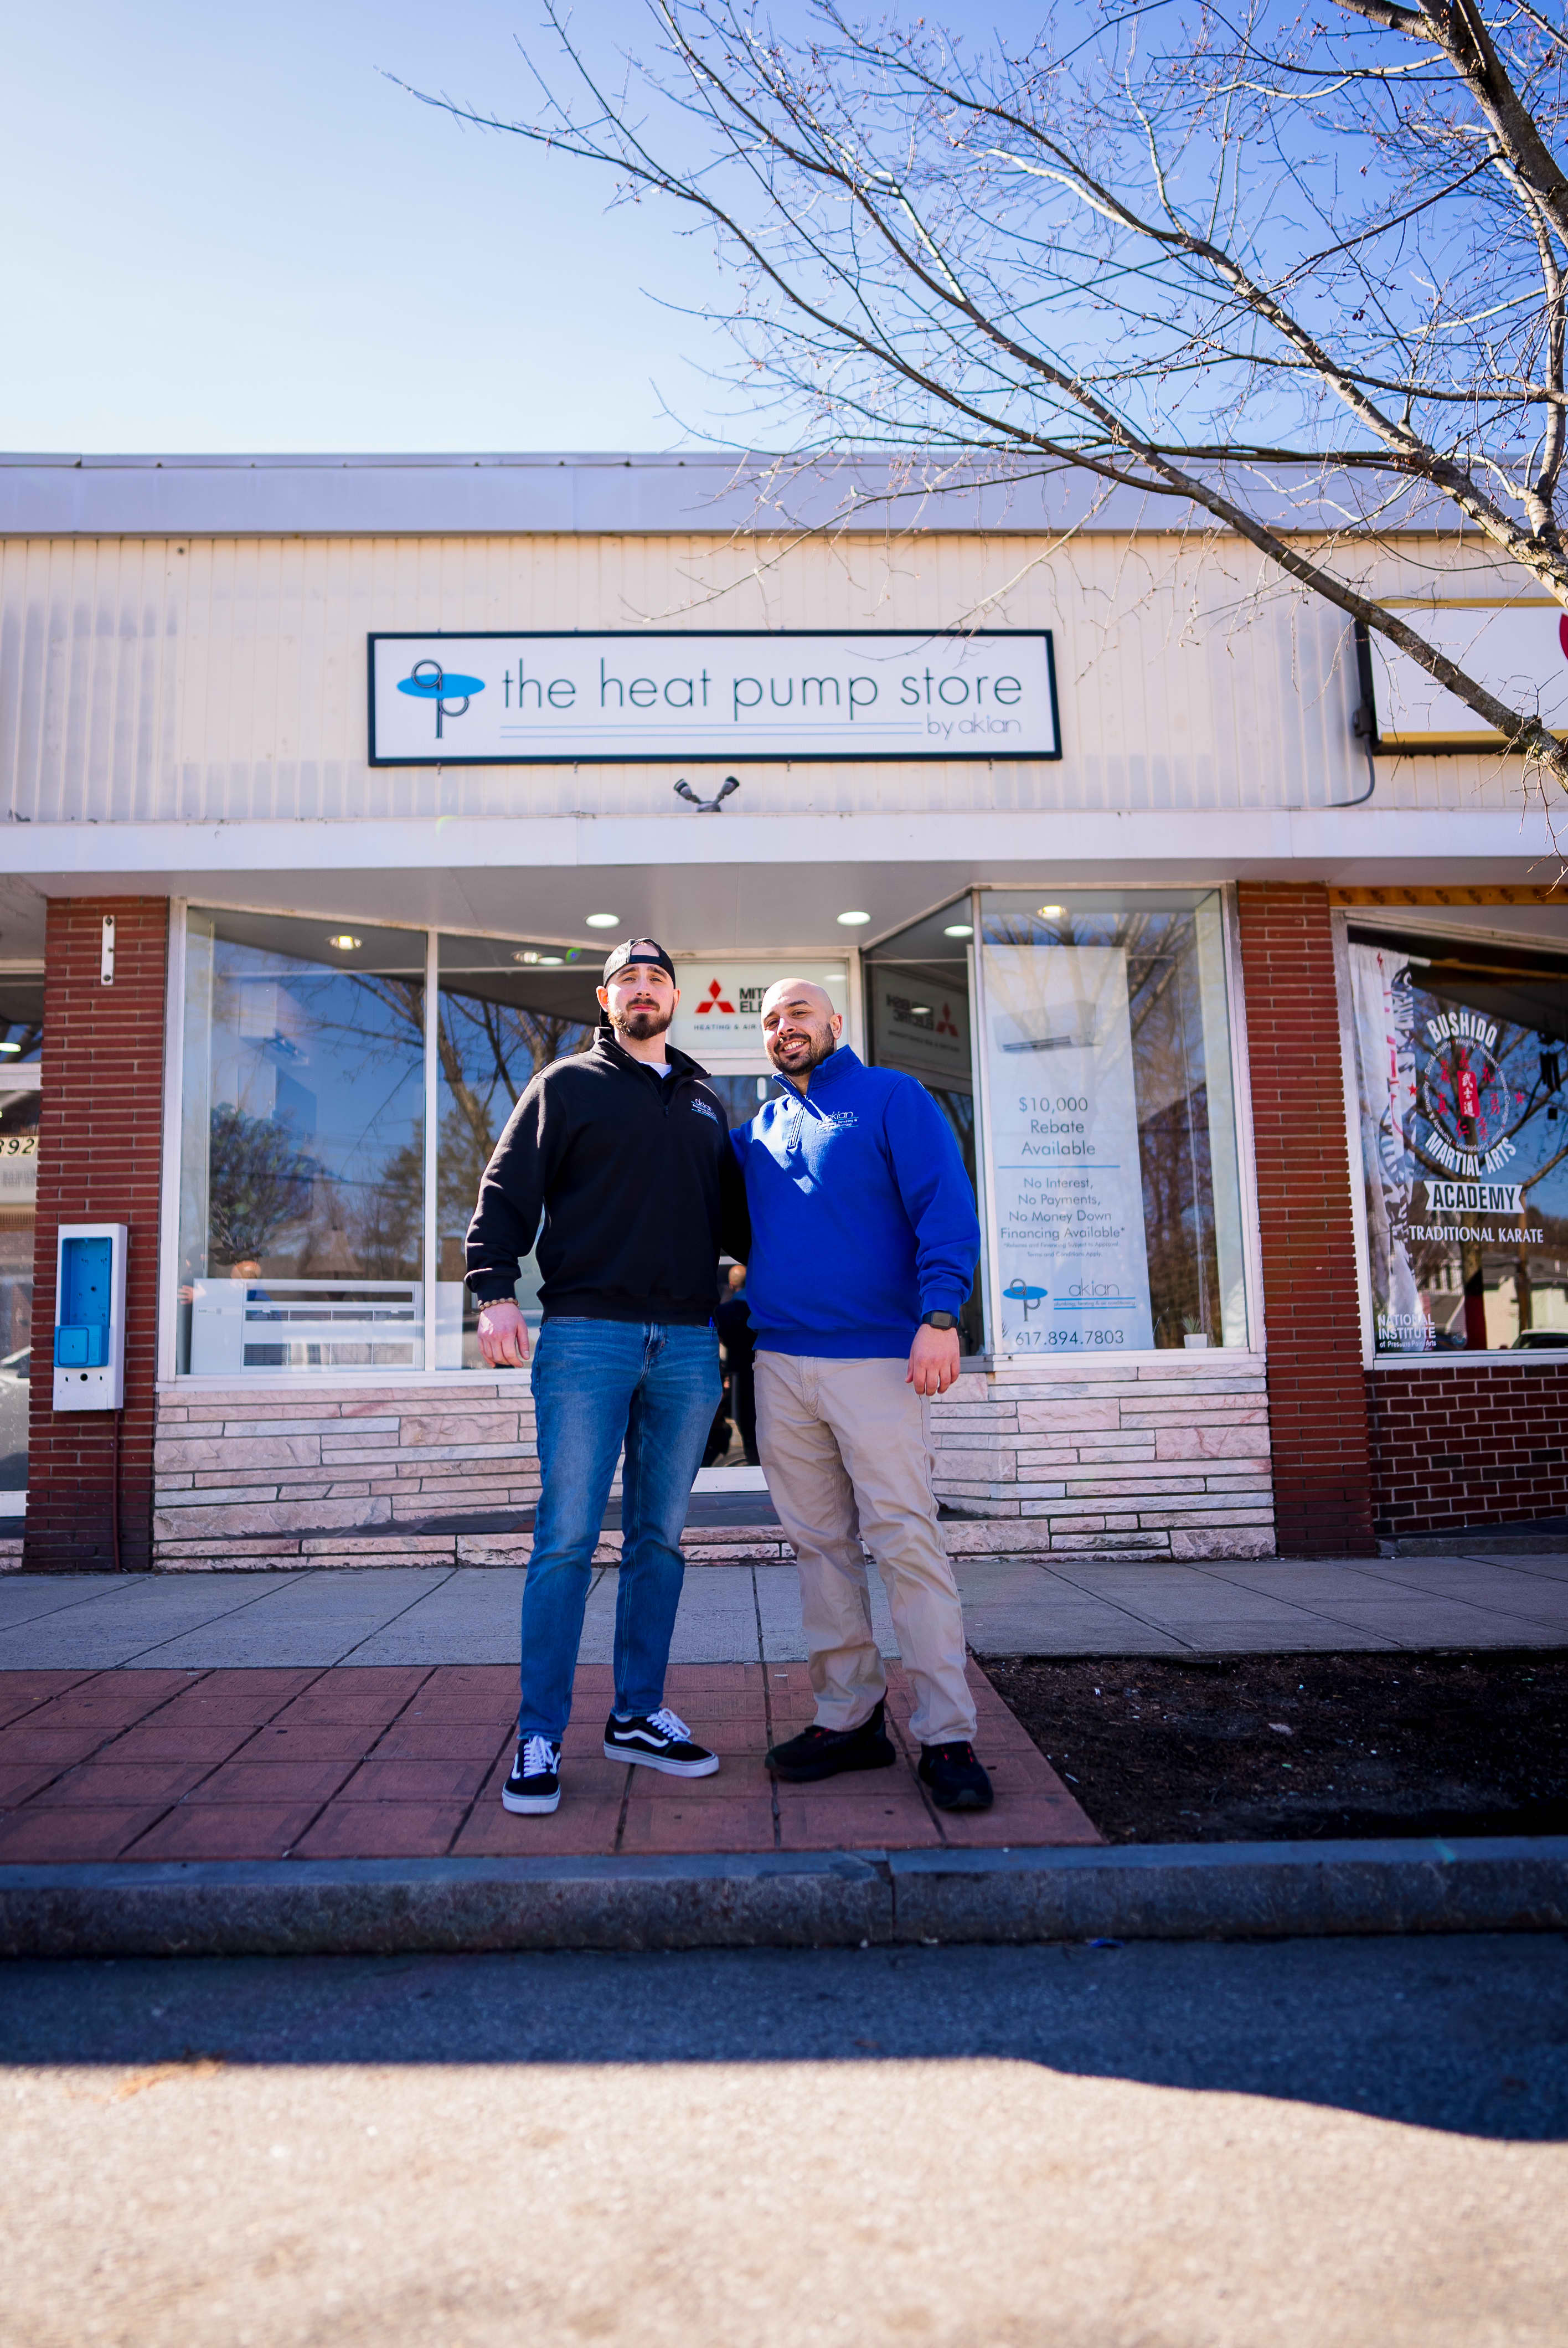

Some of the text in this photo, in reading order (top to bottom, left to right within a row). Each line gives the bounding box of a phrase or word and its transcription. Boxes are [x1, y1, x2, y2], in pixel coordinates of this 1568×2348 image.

[502, 657, 1022, 722] the heat pump store
[927, 712, 1022, 740] by akian
[1426, 1011, 1498, 1048] BUSHIDO
[1018, 1096, 1089, 1115] $10,000
[1030, 1119, 1085, 1134] Rebate
[1020, 1140, 1096, 1155] Available
[1425, 1130, 1517, 1177] MARTIAL ARTS
[1023, 1177, 1094, 1190] No Interest,
[1018, 1193, 1101, 1207] No Payments,
[1433, 1183, 1515, 1210] ACADEMY
[1009, 1209, 1112, 1223] No Money Down
[1000, 1227, 1060, 1241] Financing
[1409, 1224, 1544, 1243] TRADITIONAL KARATE
[1069, 1278, 1120, 1297] akian
[1015, 1330, 1124, 1346] 617.894.7803
[1378, 1326, 1437, 1340] INSTITUTE
